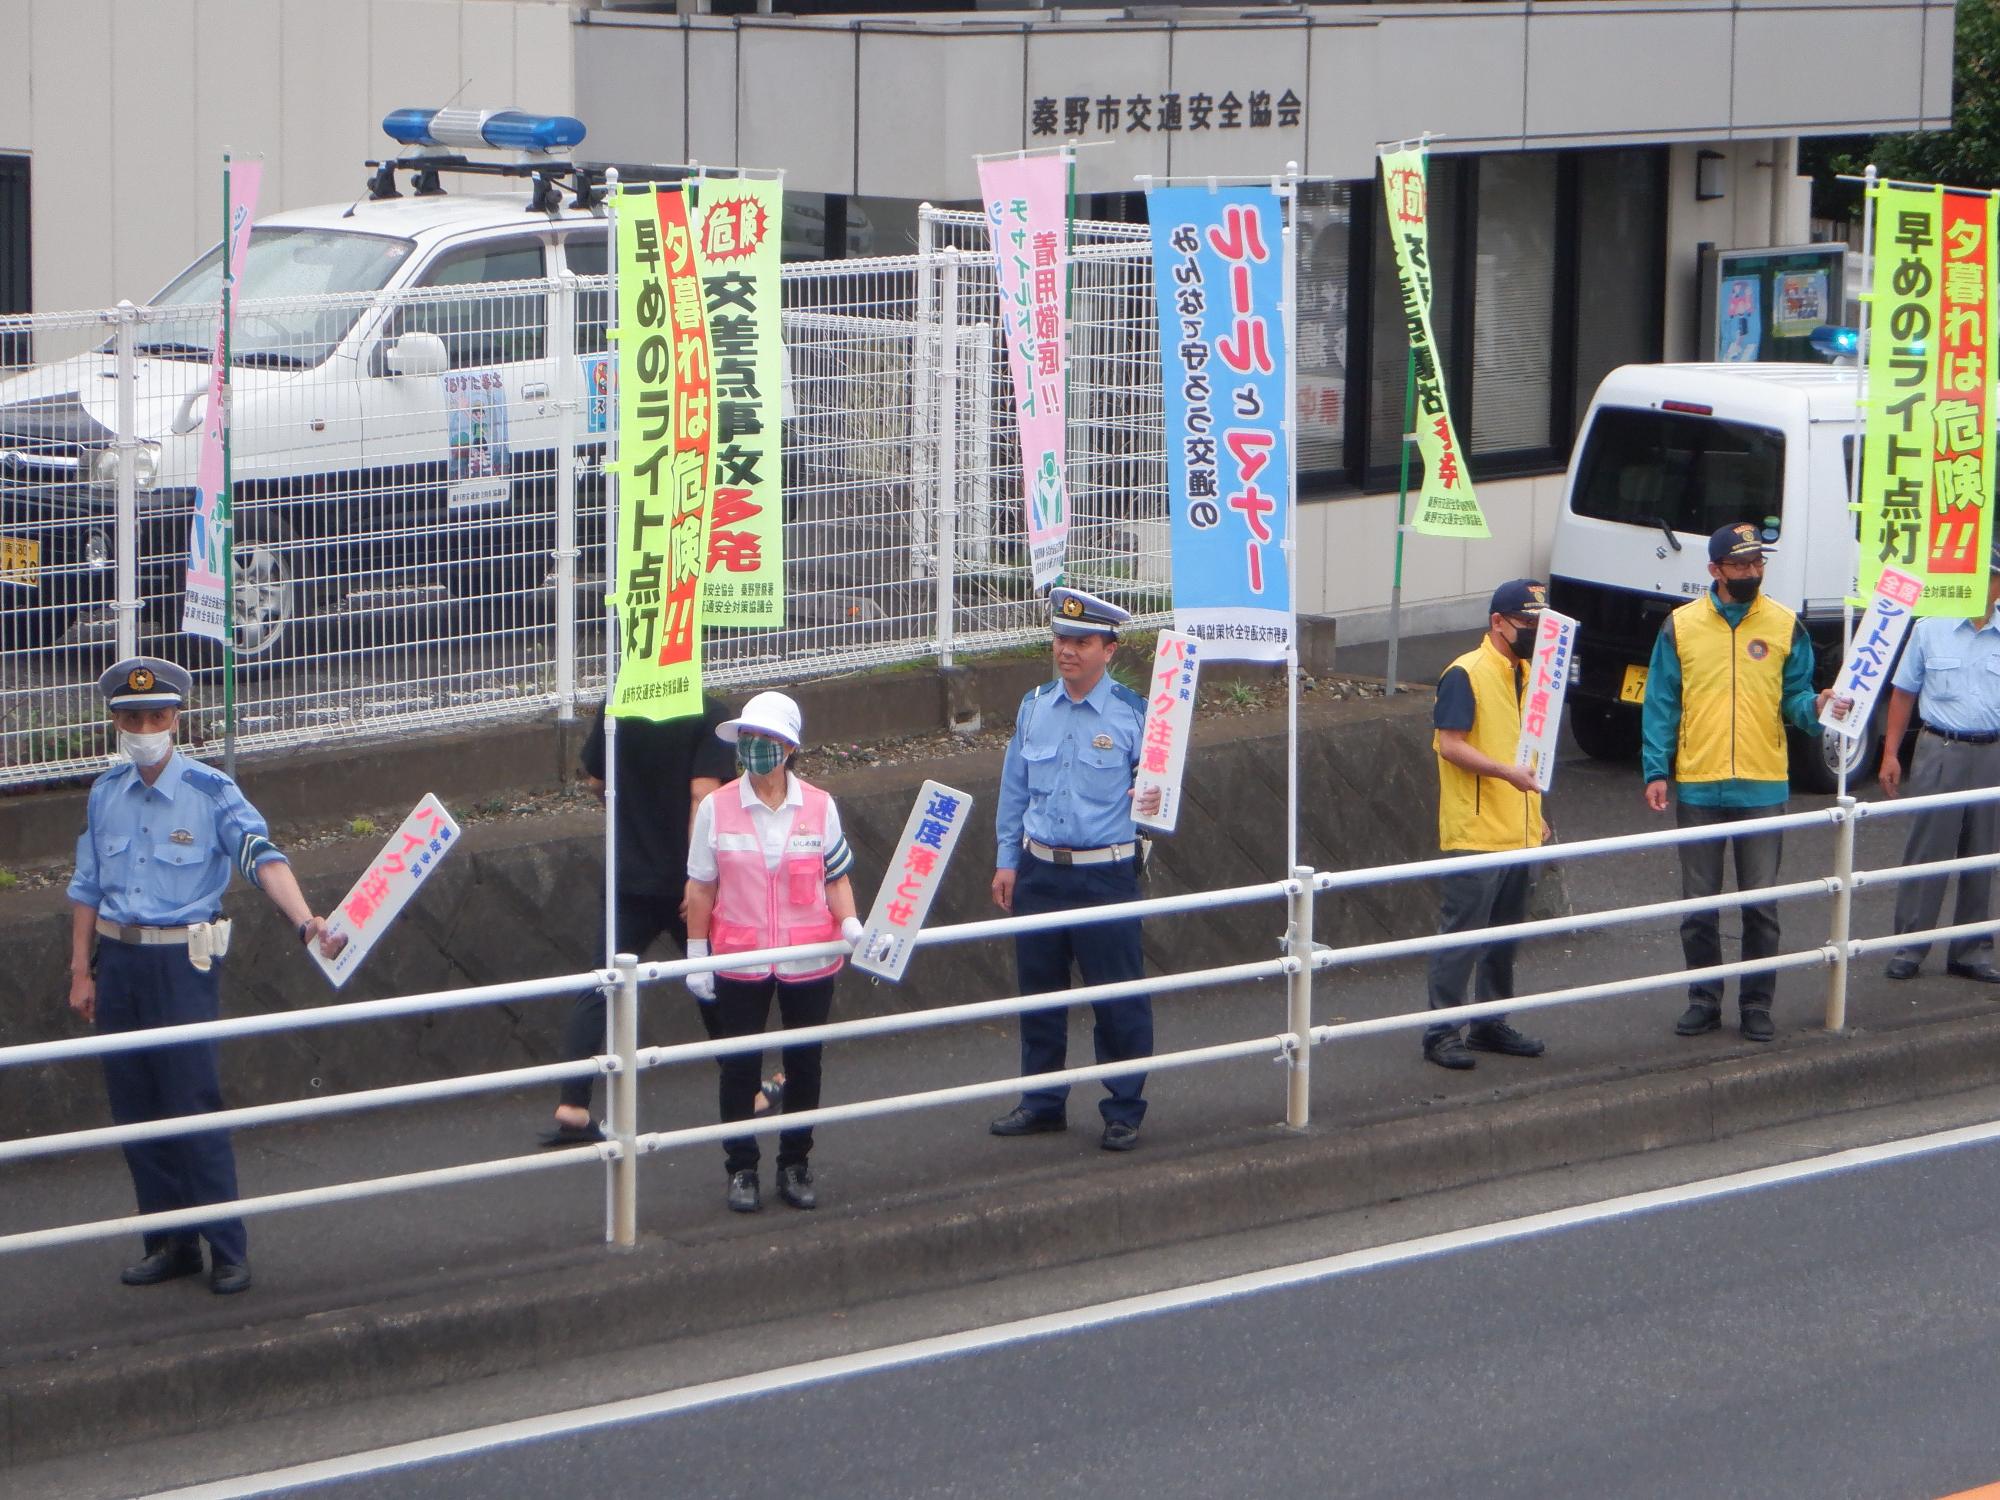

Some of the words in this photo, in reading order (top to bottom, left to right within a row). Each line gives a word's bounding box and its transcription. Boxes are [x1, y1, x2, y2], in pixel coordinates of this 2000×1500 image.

[1032, 88, 1301, 136] 秦野市交通安全協会
[706, 201, 758, 254] 危険
[626, 218, 670, 662] 早めのライト点灯
[702, 271, 764, 573] 交差点事故多発
[1878, 210, 1934, 565] 早めのライト点灯
[1849, 598, 1904, 692] シートベルト
[1883, 574, 1918, 604] 全席
[1139, 639, 1187, 774] バイク注意
[1178, 643, 1197, 701] 事故多発
[1525, 617, 1560, 738] ライト点灯
[344, 806, 445, 929] バイク注意
[885, 790, 961, 928] 速度落とせ
